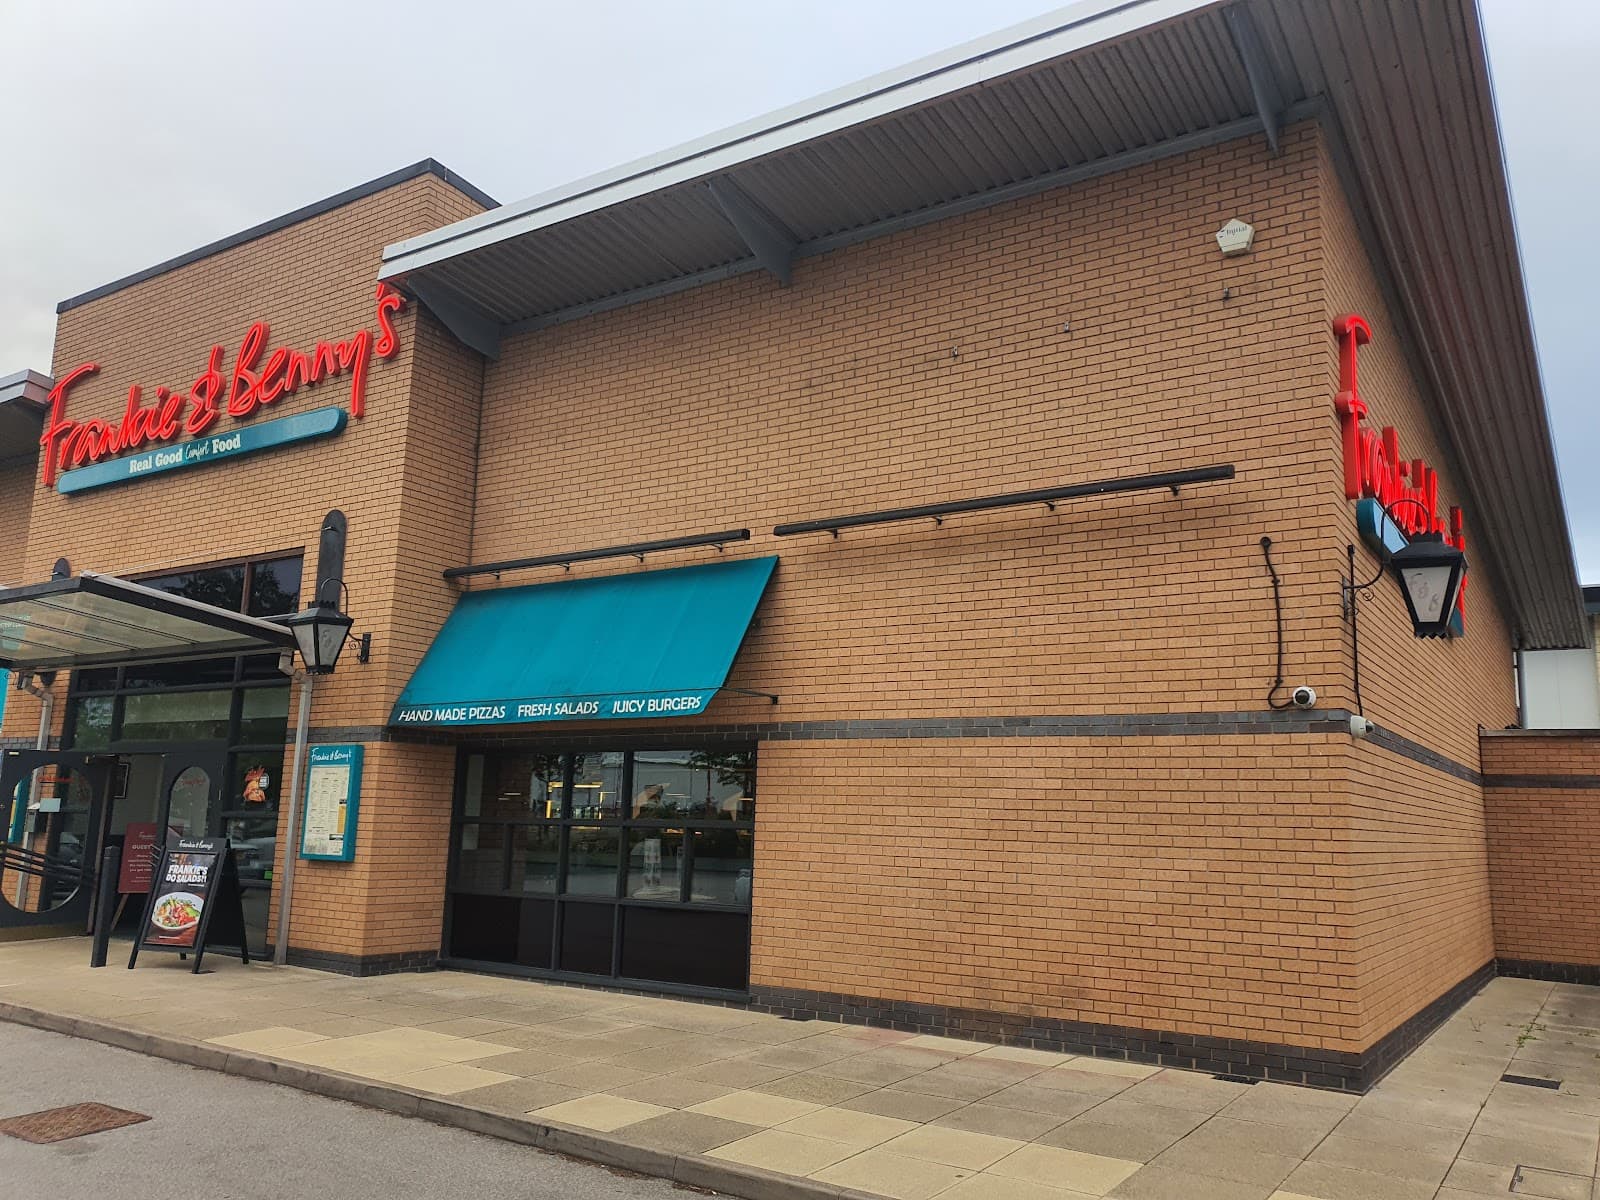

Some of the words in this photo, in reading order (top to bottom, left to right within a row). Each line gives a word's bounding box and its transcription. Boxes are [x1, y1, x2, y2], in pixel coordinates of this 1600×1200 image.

[40, 362, 186, 488] Frankie
[186, 344, 225, 437] &
[227, 283, 408, 420] Benny's
[129, 455, 152, 473] Real
[155, 448, 183, 467] Good
[185, 440, 210, 460] Comfort
[211, 433, 241, 454] Food
[398, 709, 433, 722] HAND
[434, 707, 466, 721] MADE
[468, 705, 506, 720] PIZZAS
[517, 702, 552, 718] FRESH
[553, 701, 600, 715] SALADS
[612, 699, 645, 714] JUICY
[647, 696, 702, 712] BURGERS
[165, 873, 176, 882] DO
[168, 864, 208, 875] FRANKIE'S
